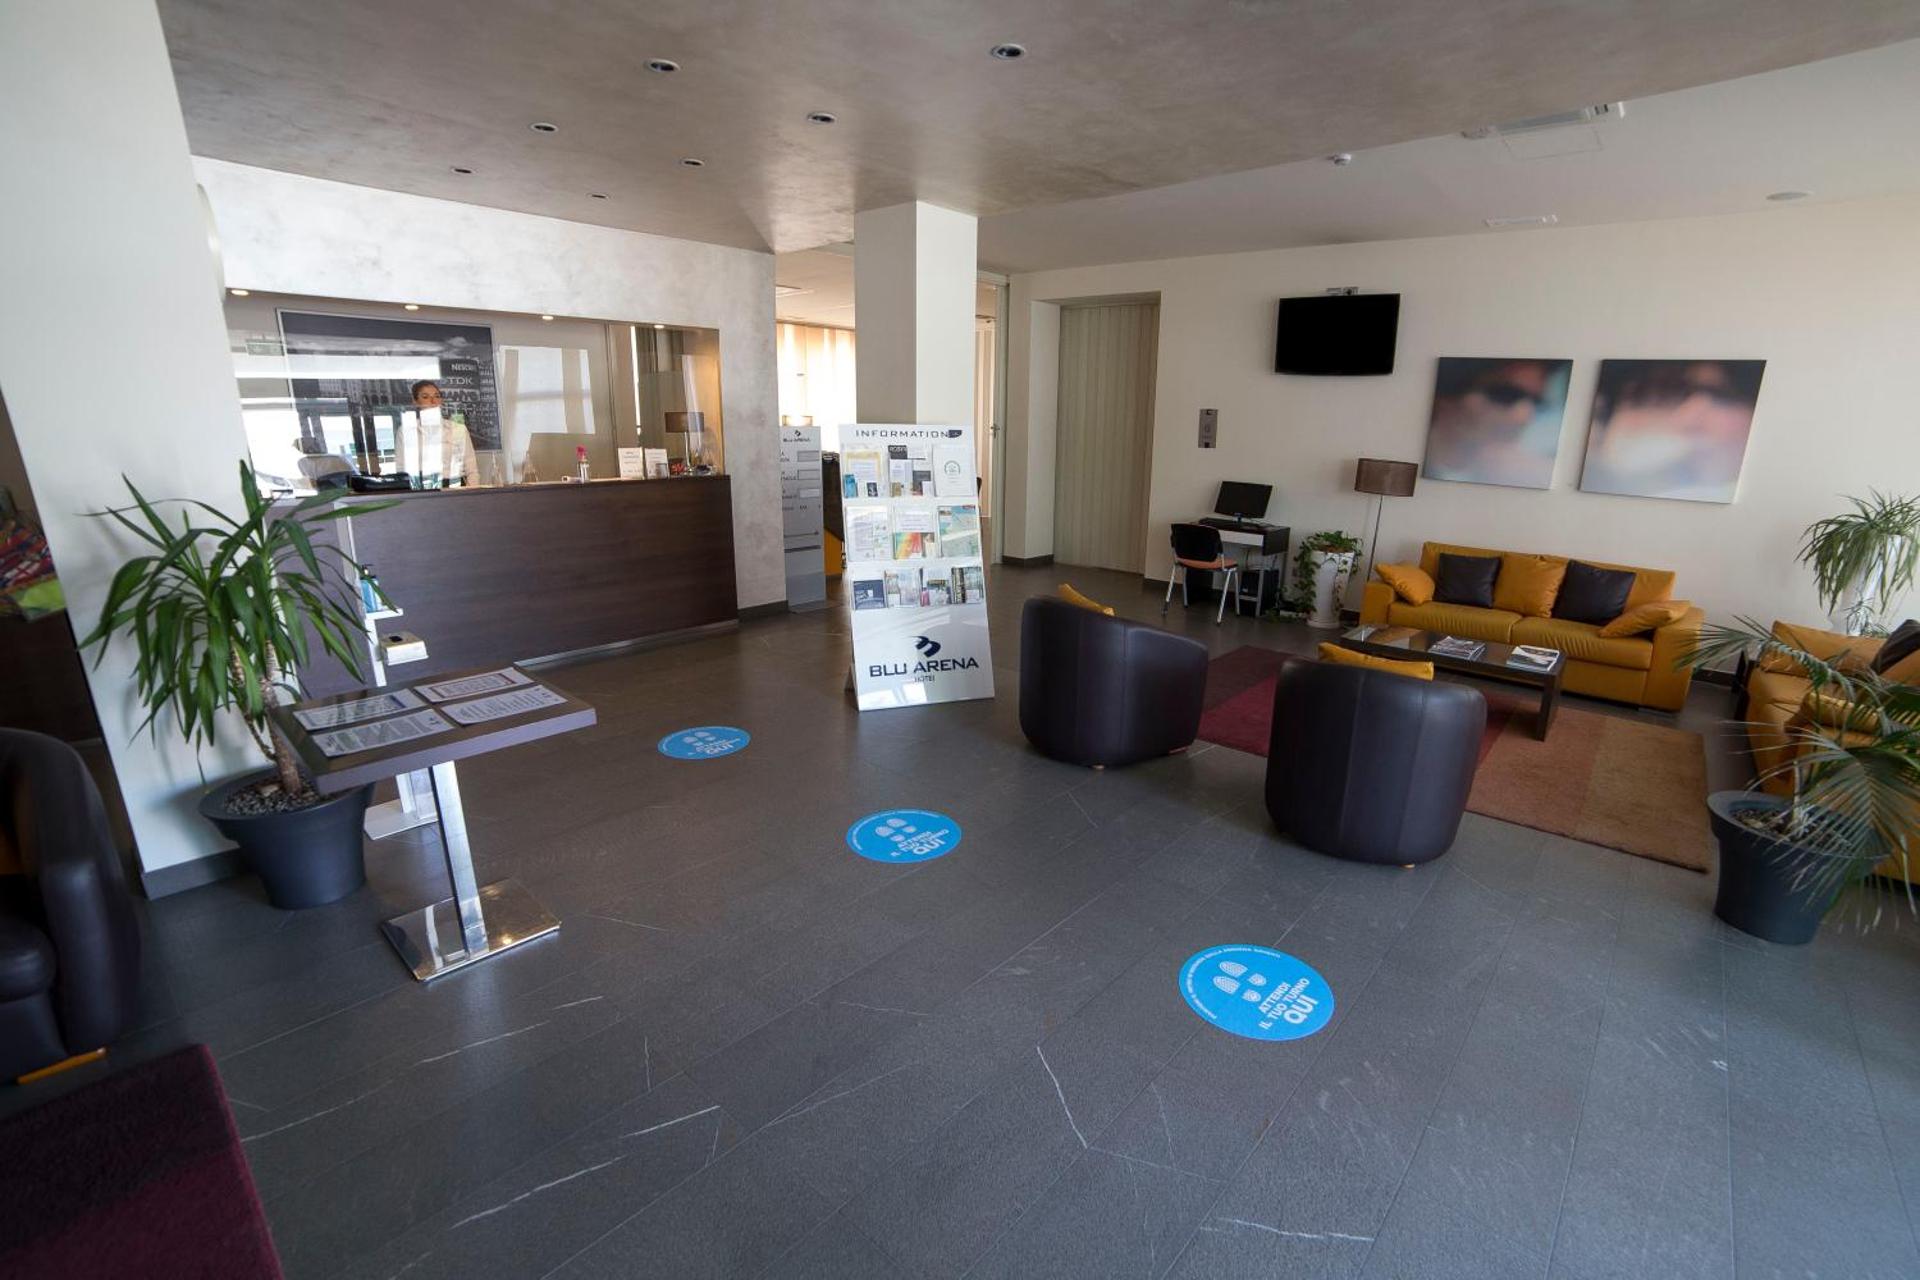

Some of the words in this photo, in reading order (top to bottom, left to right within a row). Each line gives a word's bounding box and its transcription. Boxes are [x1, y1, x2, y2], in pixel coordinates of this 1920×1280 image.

[855, 429, 949, 439] INFORMATION
[869, 663, 907, 677] BLU
[913, 657, 979, 673] ARENA
[1267, 1003, 1287, 1020] TUO
[1282, 978, 1310, 1003] TURNO
[1283, 994, 1319, 1024] QUI
